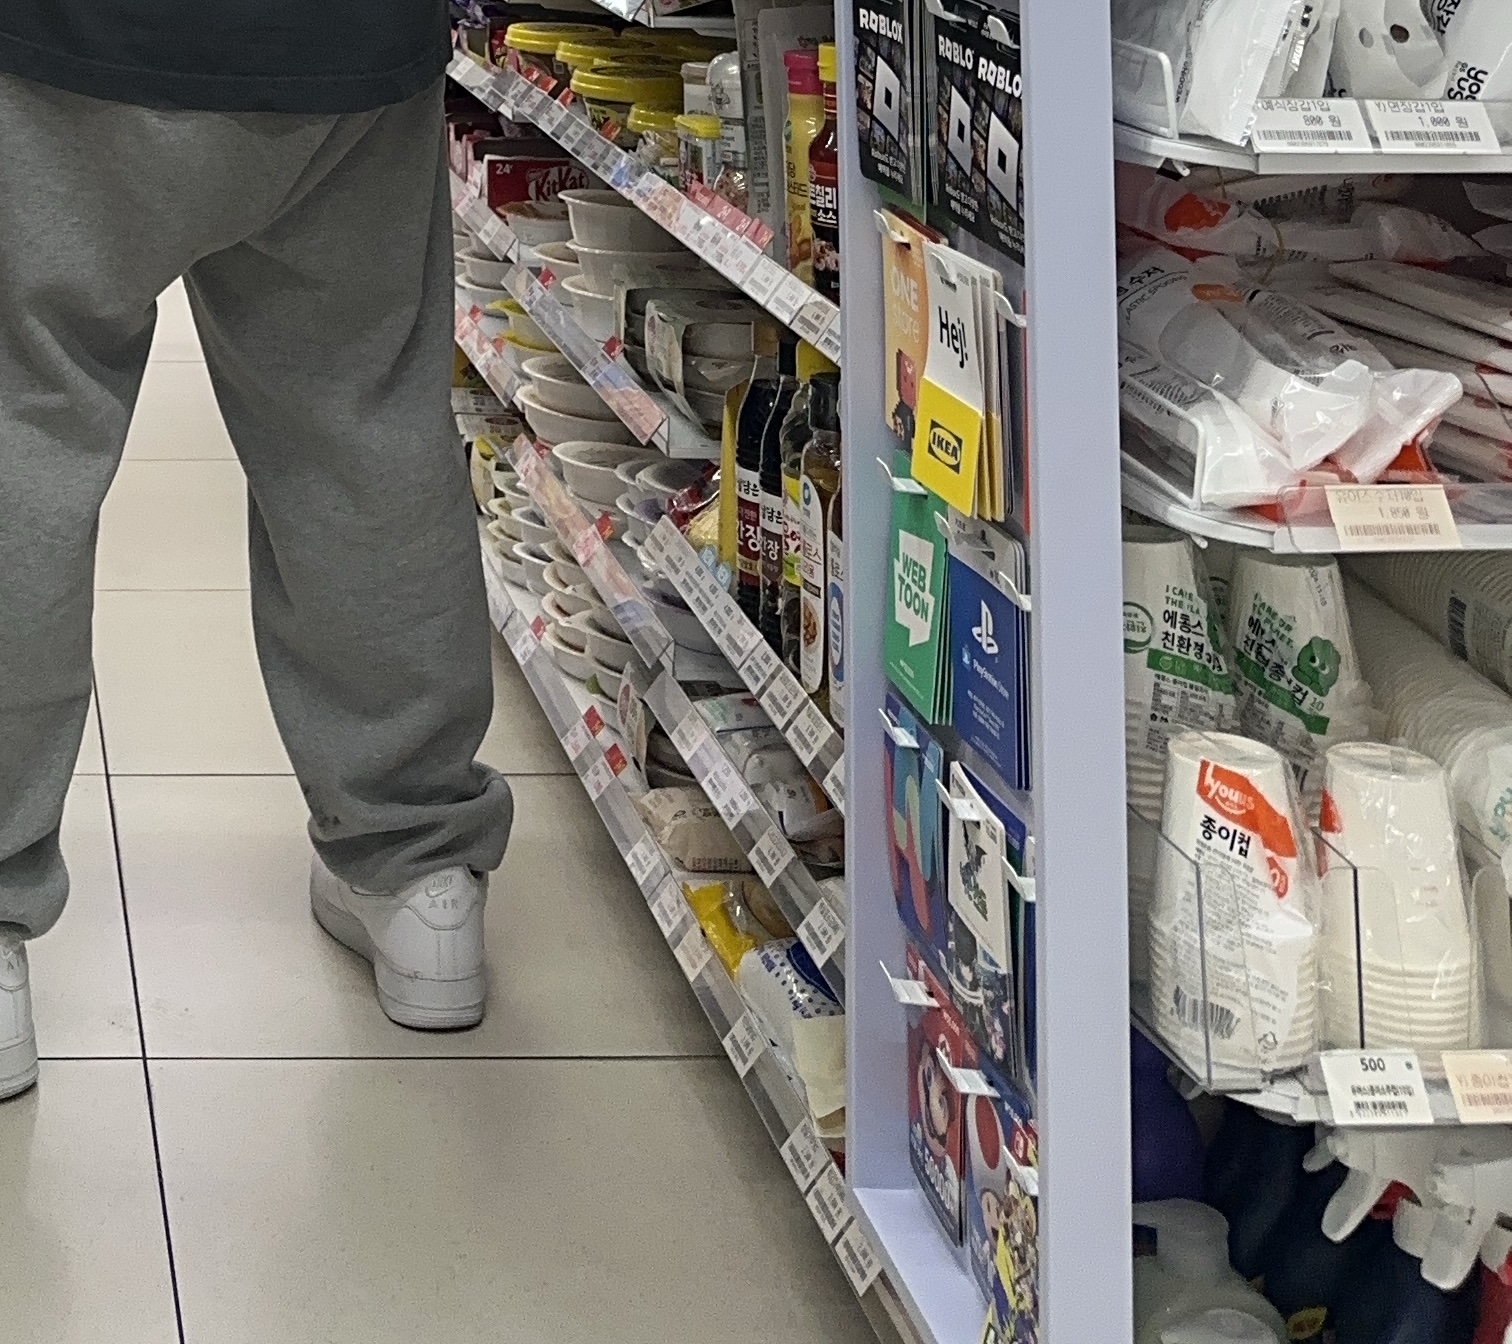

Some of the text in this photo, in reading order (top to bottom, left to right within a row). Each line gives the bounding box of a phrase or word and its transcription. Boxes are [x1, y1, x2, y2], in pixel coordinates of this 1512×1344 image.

[858, 6, 904, 45] ROBLOX
[977, 56, 1023, 100] ROBLO
[534, 166, 585, 202] KitKat
[891, 265, 920, 313] ONE
[937, 305, 969, 370] Hej!
[931, 431, 961, 462] IKEA
[900, 551, 927, 594] WEB
[897, 572, 930, 623] TOON
[1198, 812, 1253, 861] 종이컵
[1359, 1056, 1386, 1073] 500
